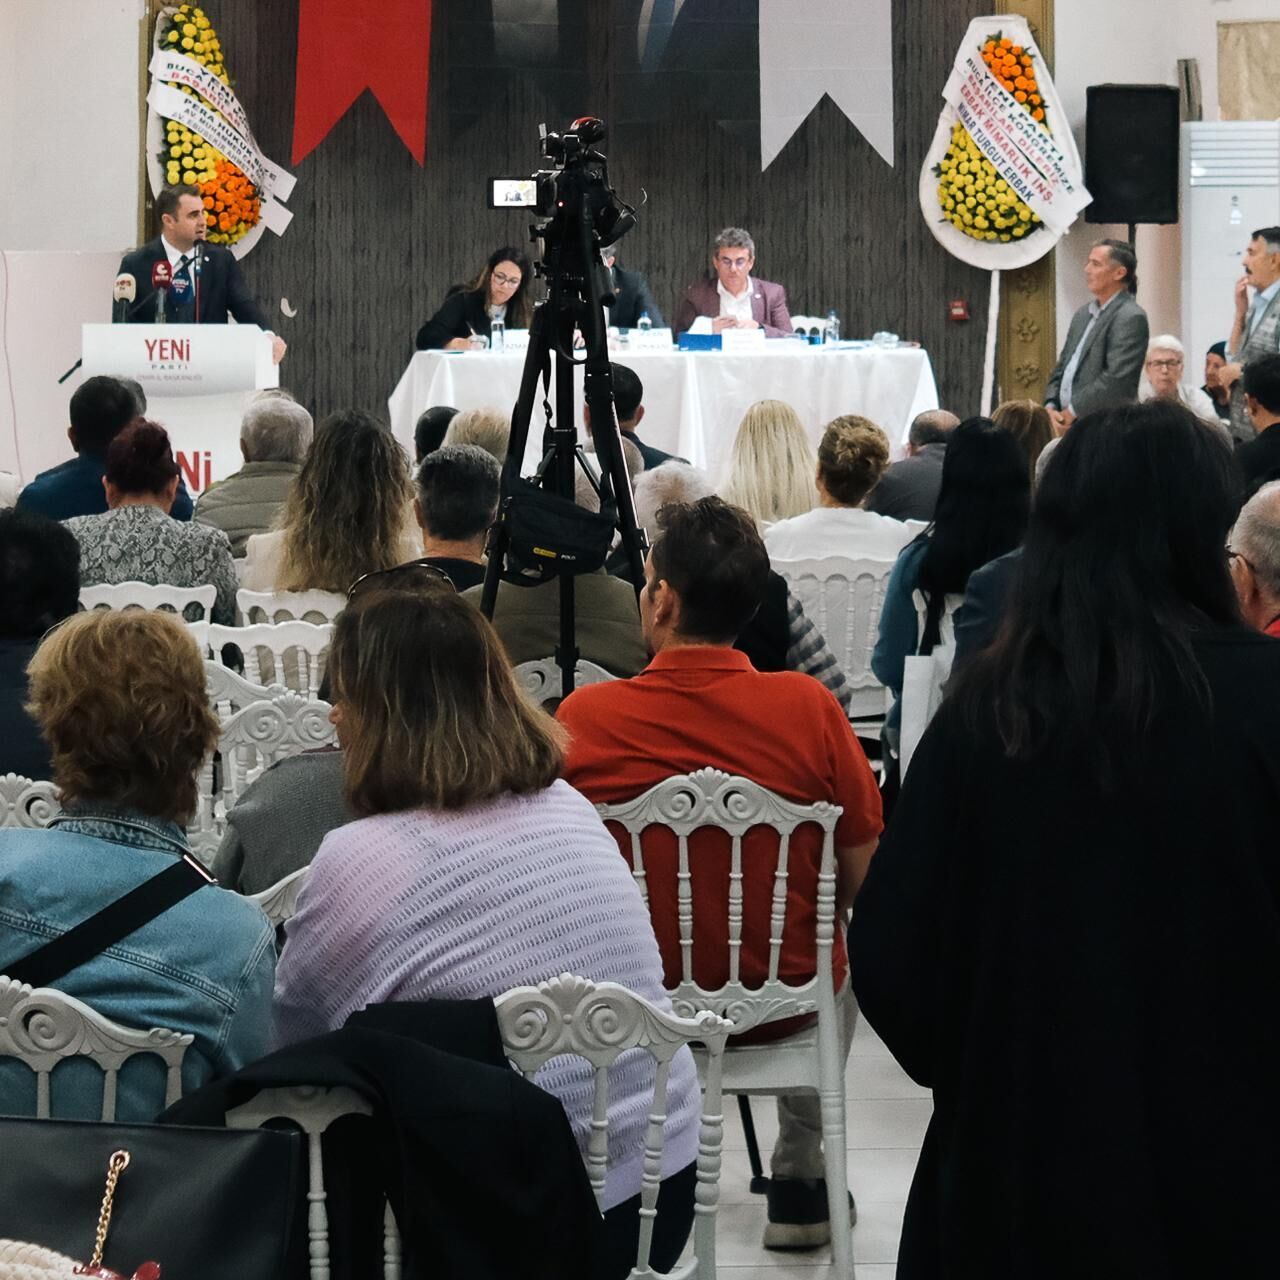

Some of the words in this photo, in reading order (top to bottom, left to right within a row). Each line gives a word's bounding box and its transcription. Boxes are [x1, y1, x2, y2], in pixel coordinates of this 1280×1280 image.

[166, 62, 204, 82] BUCA
[183, 97, 215, 123] PERA
[217, 122, 254, 157] HUKUK
[959, 83, 986, 120] ERBAK
[982, 116, 1033, 179] MİMARLIK
[973, 126, 1007, 167] TURGUT
[1003, 164, 1036, 203] ERBAK
